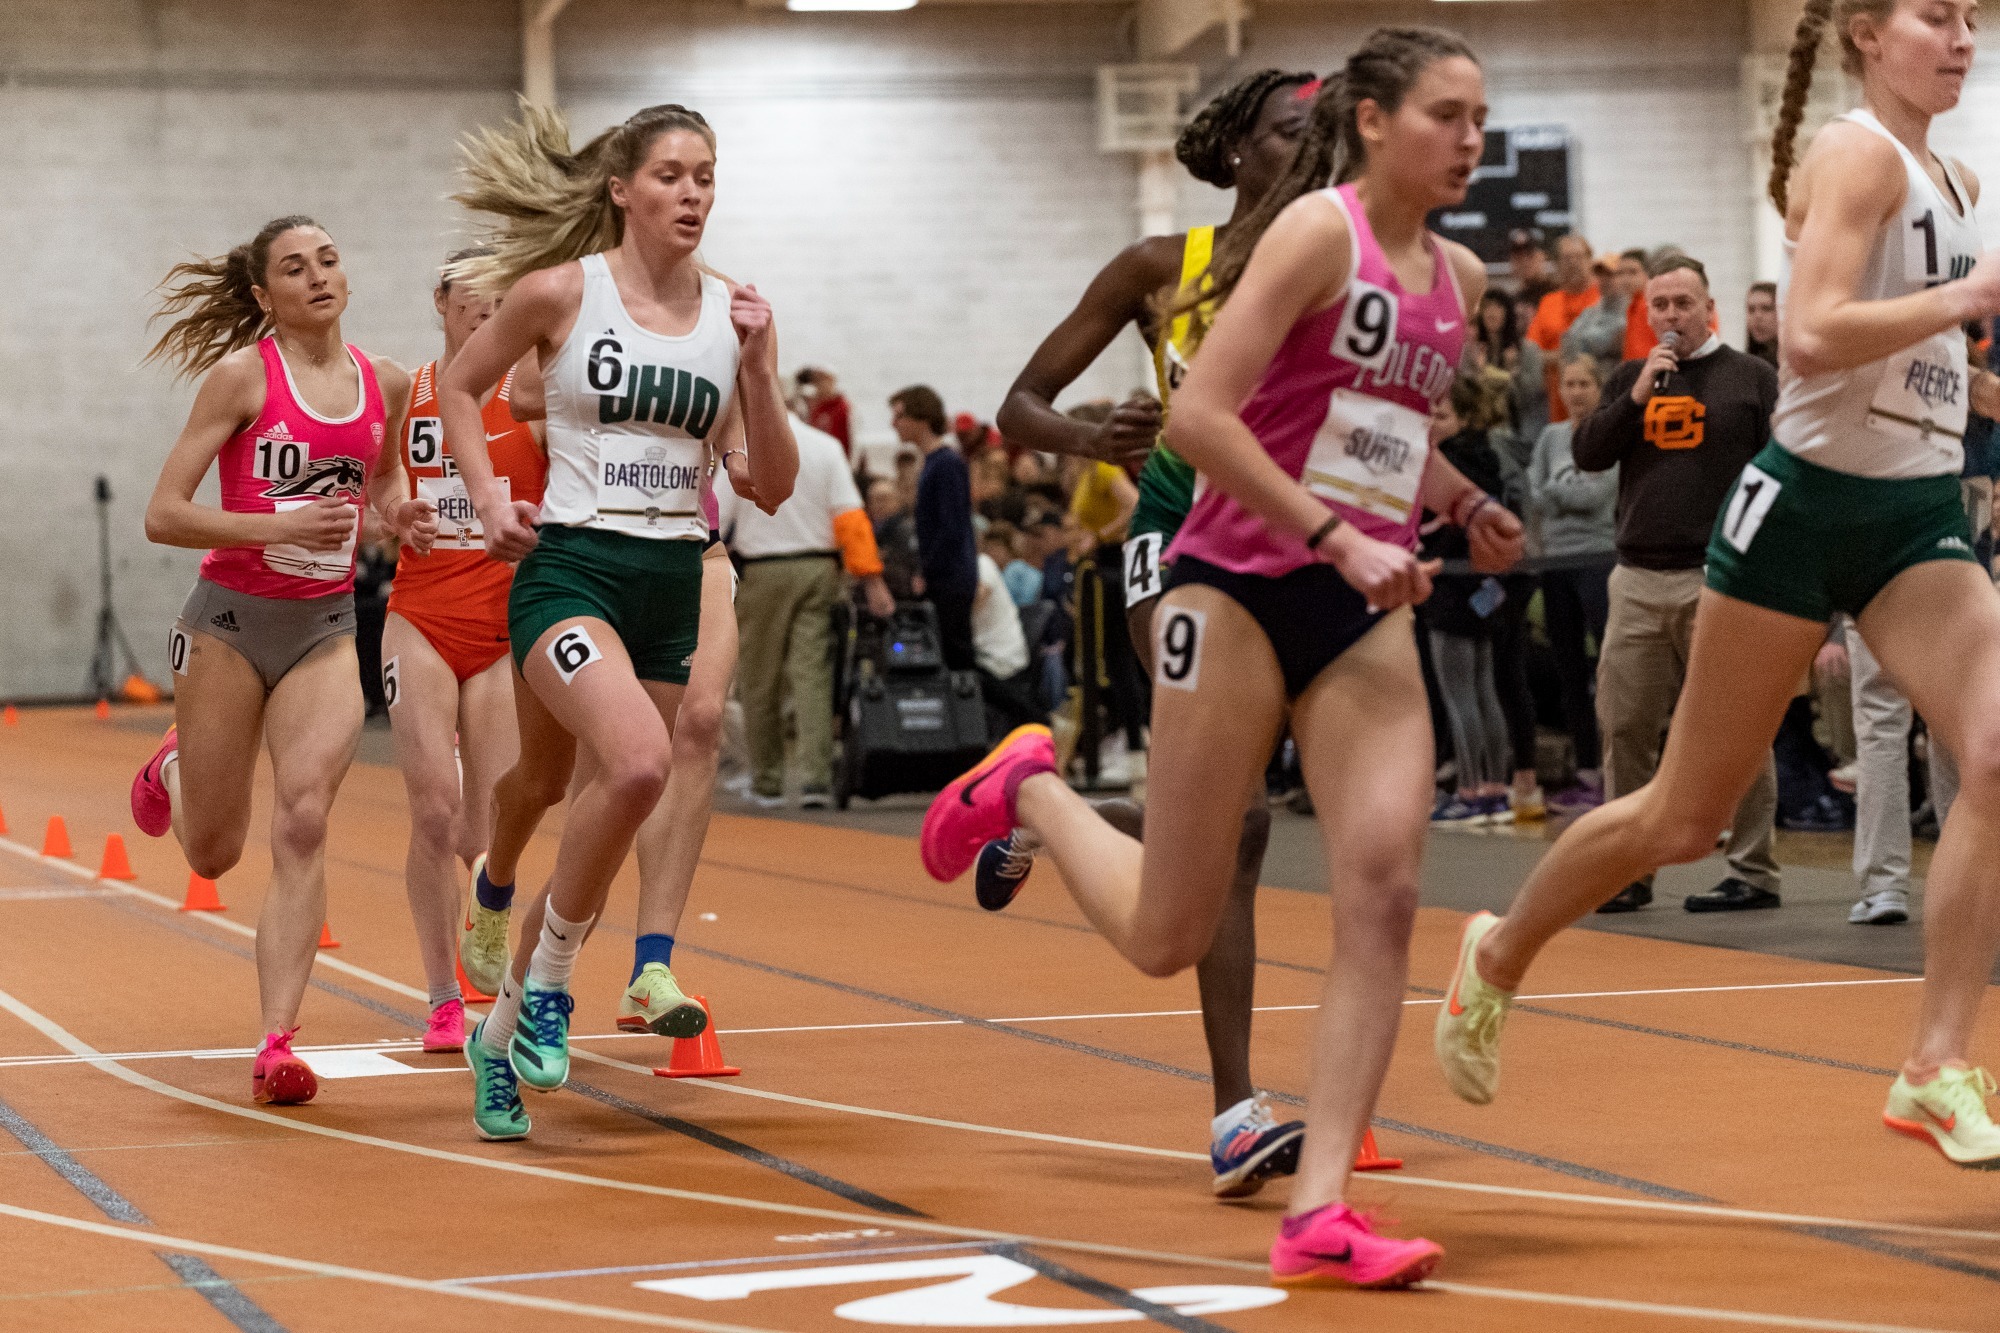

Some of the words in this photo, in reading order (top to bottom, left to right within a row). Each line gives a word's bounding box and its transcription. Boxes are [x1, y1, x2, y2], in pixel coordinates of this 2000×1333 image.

[1911, 208, 1938, 275] 1
[1347, 290, 1390, 357] 9
[587, 338, 623, 391] 6
[1904, 358, 1960, 405] PIERCE
[263, 432, 294, 441] adidas
[411, 420, 437, 463] 5
[258, 441, 301, 480] 10
[604, 462, 700, 489] BARTOLONE
[1731, 478, 1764, 538] 1
[1128, 540, 1153, 592] 4
[210, 616, 241, 633] adidas
[1163, 613, 1197, 681] 9
[554, 632, 590, 674] 6
